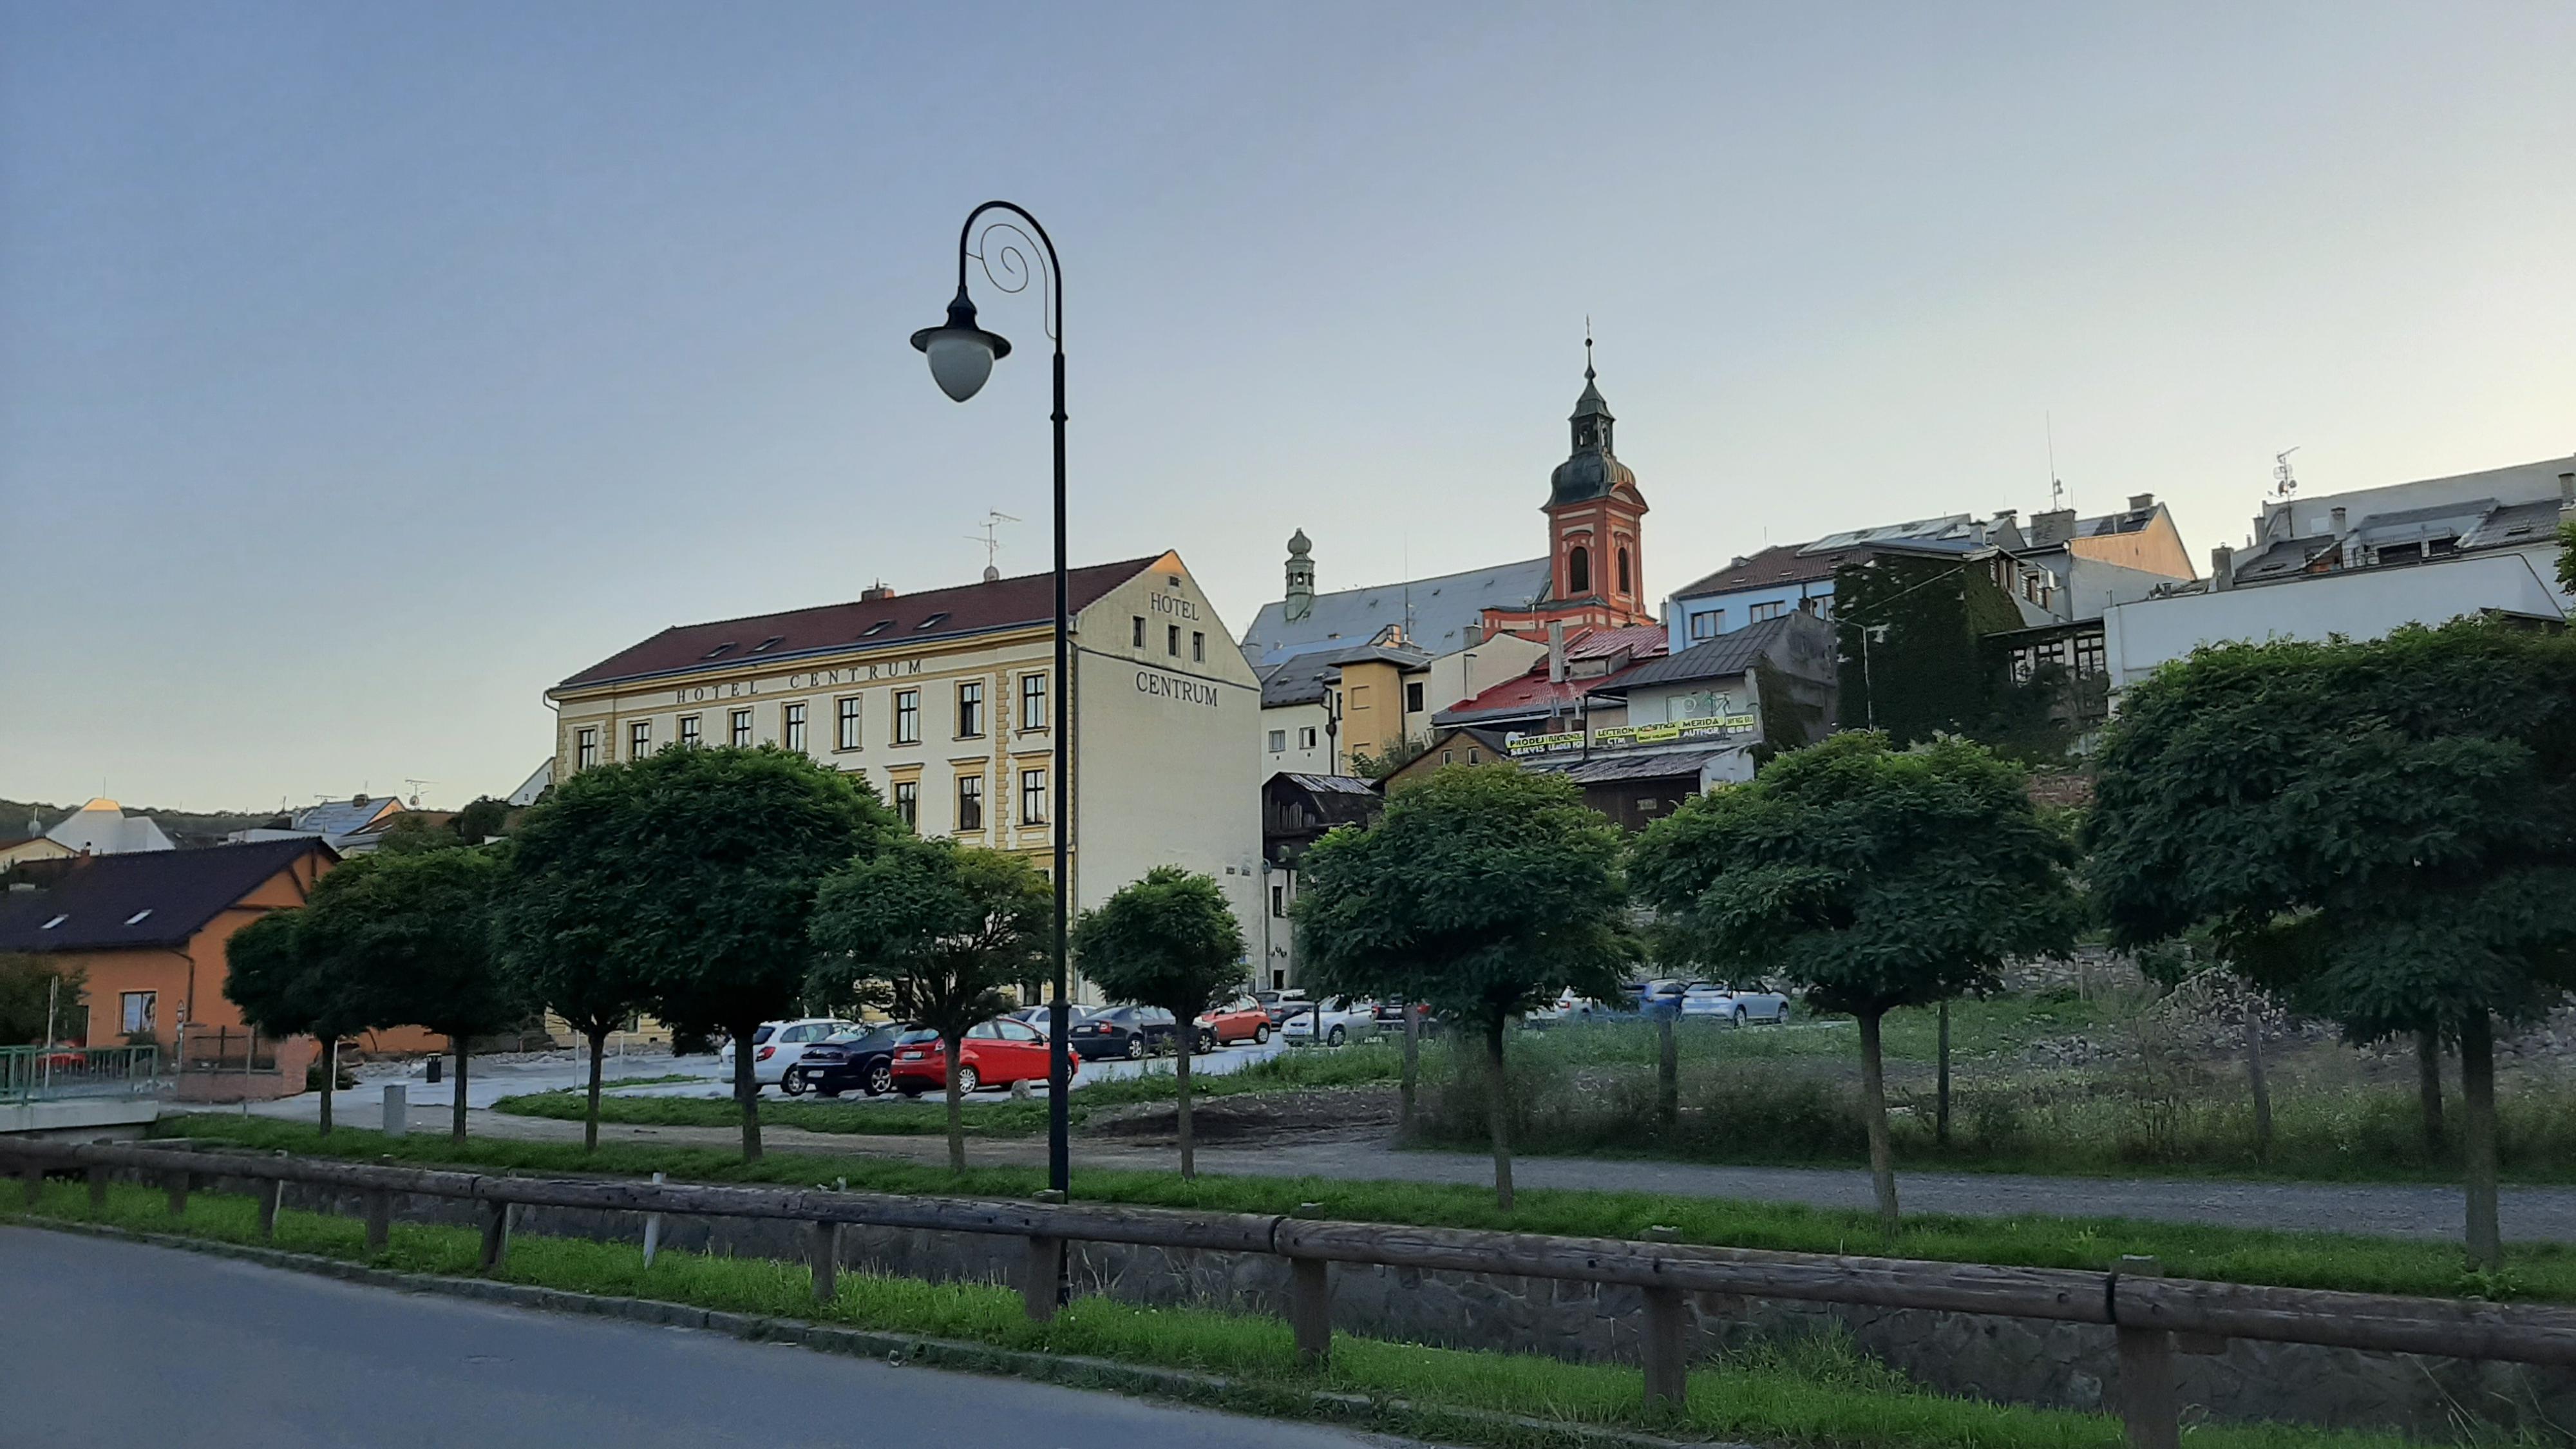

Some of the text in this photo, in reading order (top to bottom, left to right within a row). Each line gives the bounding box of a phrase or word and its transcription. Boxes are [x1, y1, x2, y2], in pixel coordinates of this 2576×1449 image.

[1150, 592, 1200, 621] HOTEL
[677, 659, 922, 703] HOTEL CENTRUM
[1136, 671, 1218, 707] CENTRUM
[1683, 718, 1719, 728] MERIDA
[1598, 728, 1634, 736] LECTRON
[1683, 726, 1719, 737] AUTHOR
[1510, 737, 1544, 746] PRODEJ
[1510, 744, 1545, 756] SERVIS
